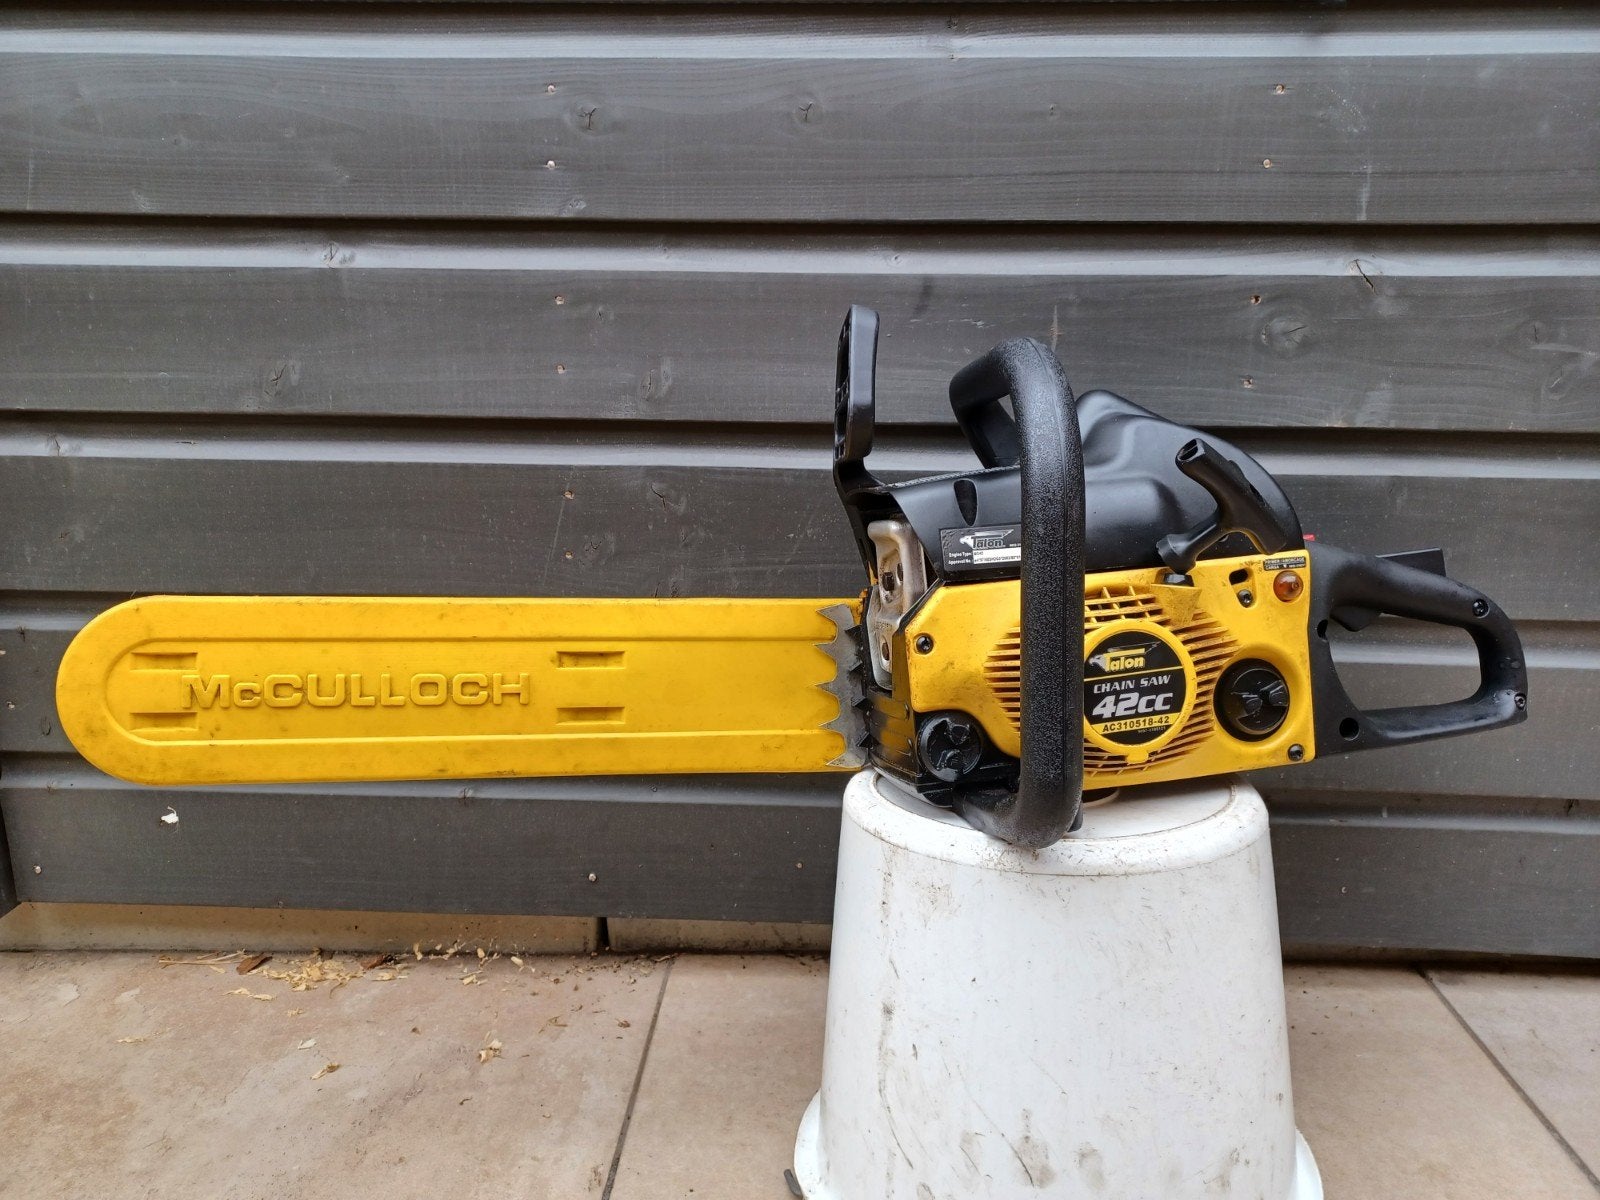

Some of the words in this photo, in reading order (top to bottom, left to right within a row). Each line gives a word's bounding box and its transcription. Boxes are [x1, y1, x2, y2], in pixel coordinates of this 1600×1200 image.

[971, 533, 1005, 550] Talon
[1103, 648, 1146, 672] Talon
[181, 673, 530, 708] McCULLOCH
[1093, 680, 1135, 694] CHAIN
[1140, 674, 1171, 688] SAW
[1102, 716, 1170, 733] AC310518-42
